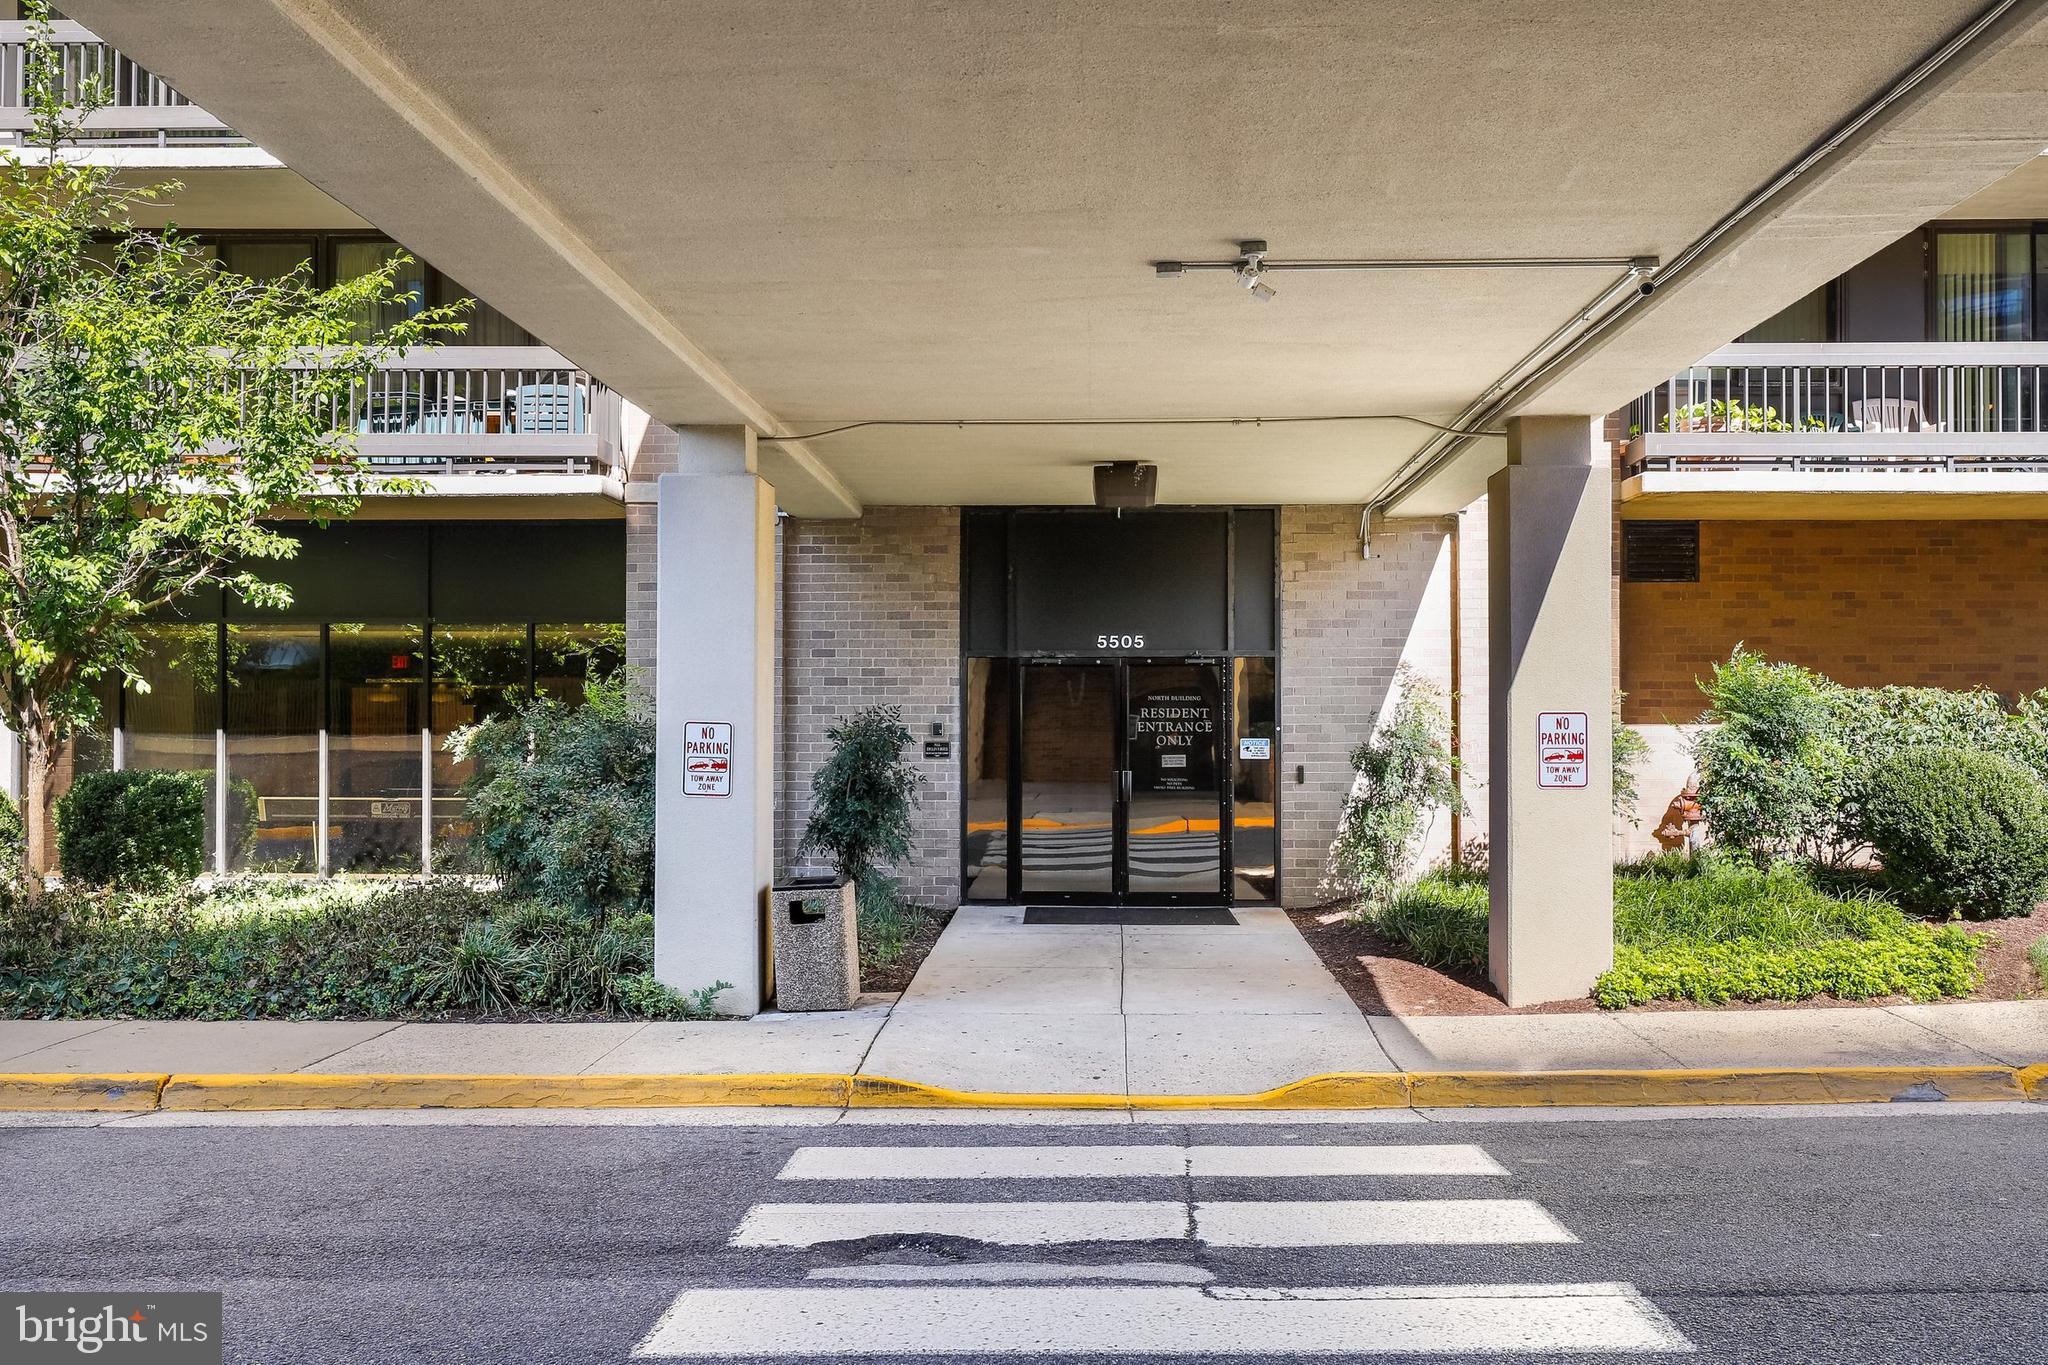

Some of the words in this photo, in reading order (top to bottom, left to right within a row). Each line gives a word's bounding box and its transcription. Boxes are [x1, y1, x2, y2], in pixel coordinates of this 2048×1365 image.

[1096, 635, 1144, 649] 5505
[392, 655, 408, 669] EXIT
[1140, 708, 1210, 719] RESIDENT
[1137, 721, 1213, 732] ENTRANCE
[1556, 717, 1569, 730] NO
[701, 727, 715, 740] NO
[1541, 732, 1584, 745] PARKING
[1156, 735, 1193, 746] ONLY
[687, 741, 729, 755] PARKING
[1546, 766, 1560, 774] TOW
[1562, 766, 1580, 774] AWAY
[690, 774, 704, 782] TOW
[705, 775, 723, 783] AWAY
[1554, 774, 1572, 782] ZONE
[698, 783, 715, 791] ZONE
